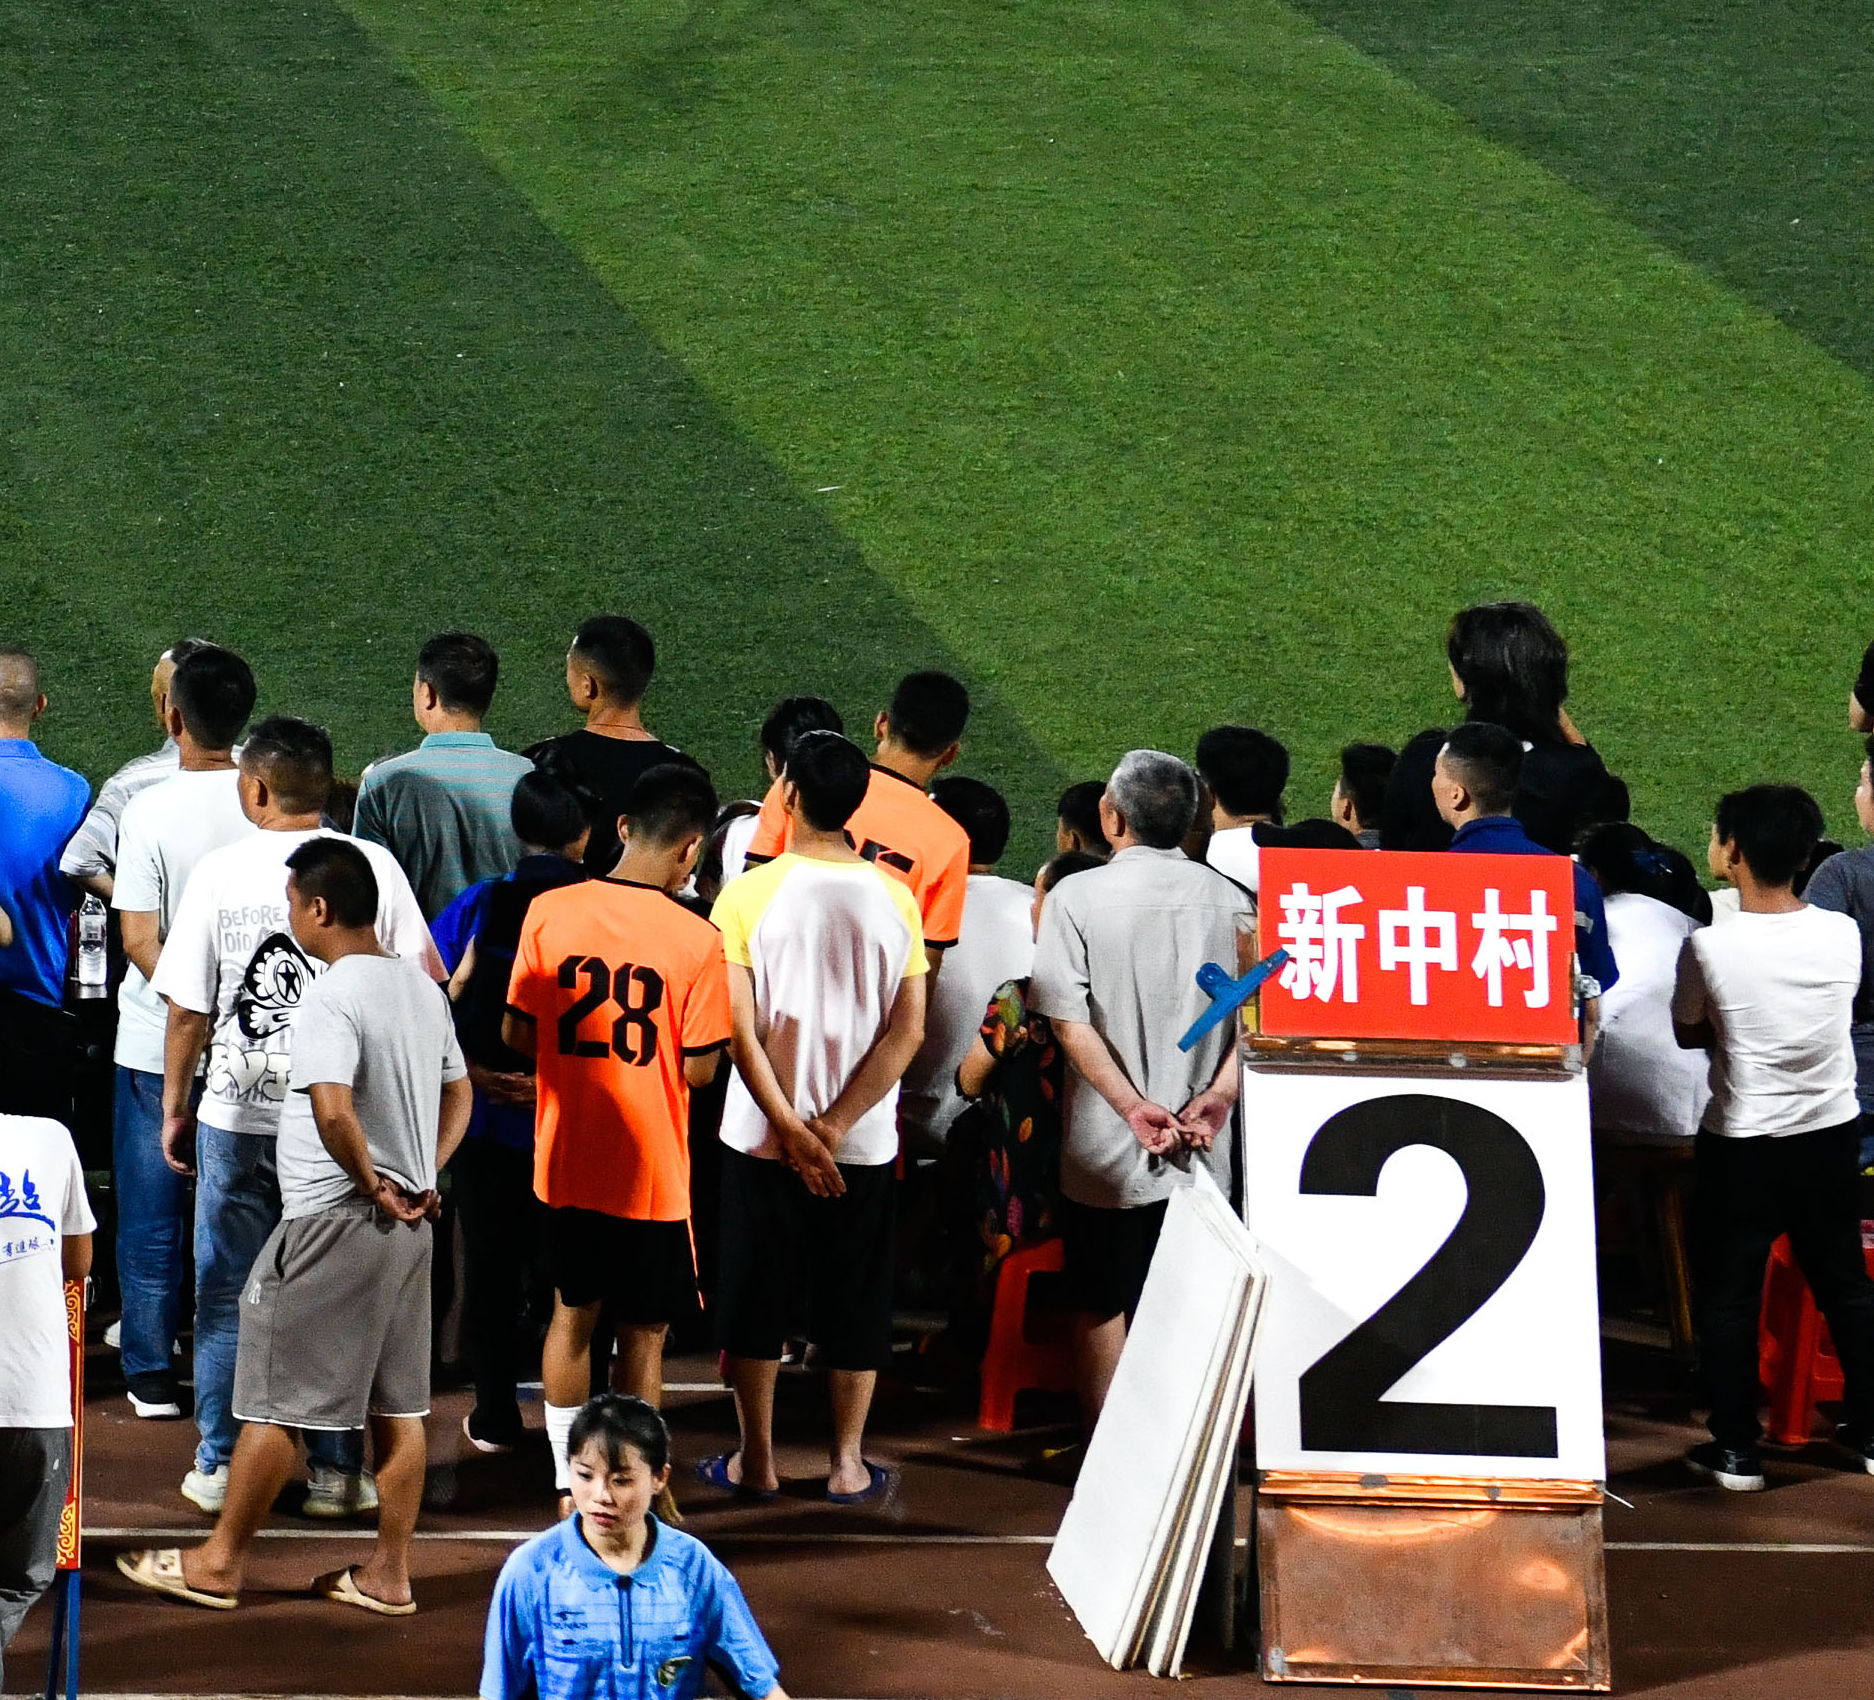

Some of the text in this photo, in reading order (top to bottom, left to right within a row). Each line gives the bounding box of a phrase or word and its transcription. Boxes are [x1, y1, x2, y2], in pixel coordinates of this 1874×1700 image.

[1277, 883, 1559, 1009] 新中村
[558, 954, 664, 1066] 28
[1299, 1093, 1559, 1458] 2
